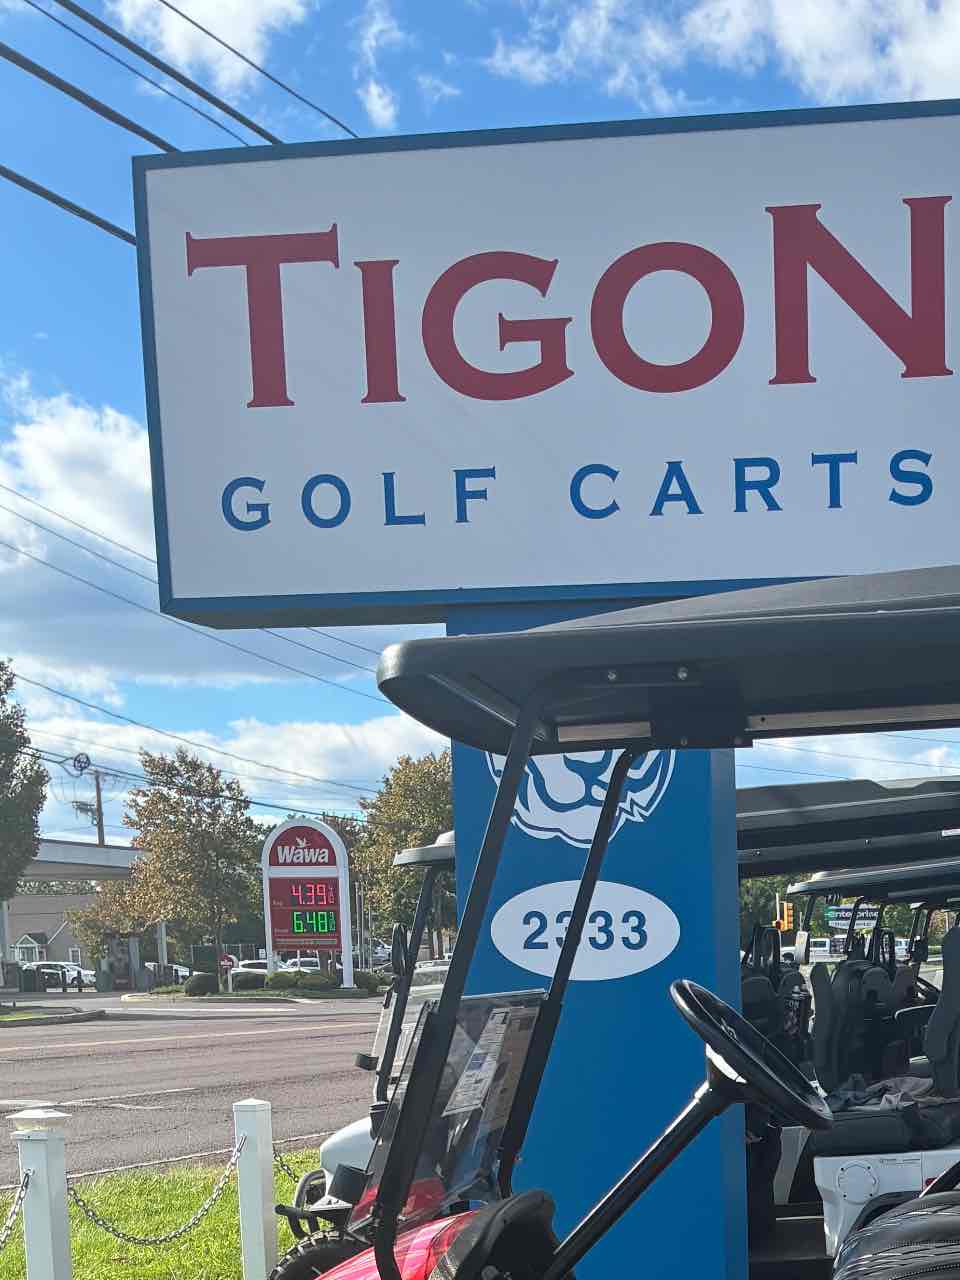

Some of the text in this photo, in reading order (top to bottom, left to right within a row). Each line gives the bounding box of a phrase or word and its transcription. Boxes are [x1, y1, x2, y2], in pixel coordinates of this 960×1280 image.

[184, 195, 954, 408] TIGON
[221, 449, 935, 532] GOLF CARTS
[277, 845, 329, 864] Wawa
[824, 909, 879, 919] enteprise
